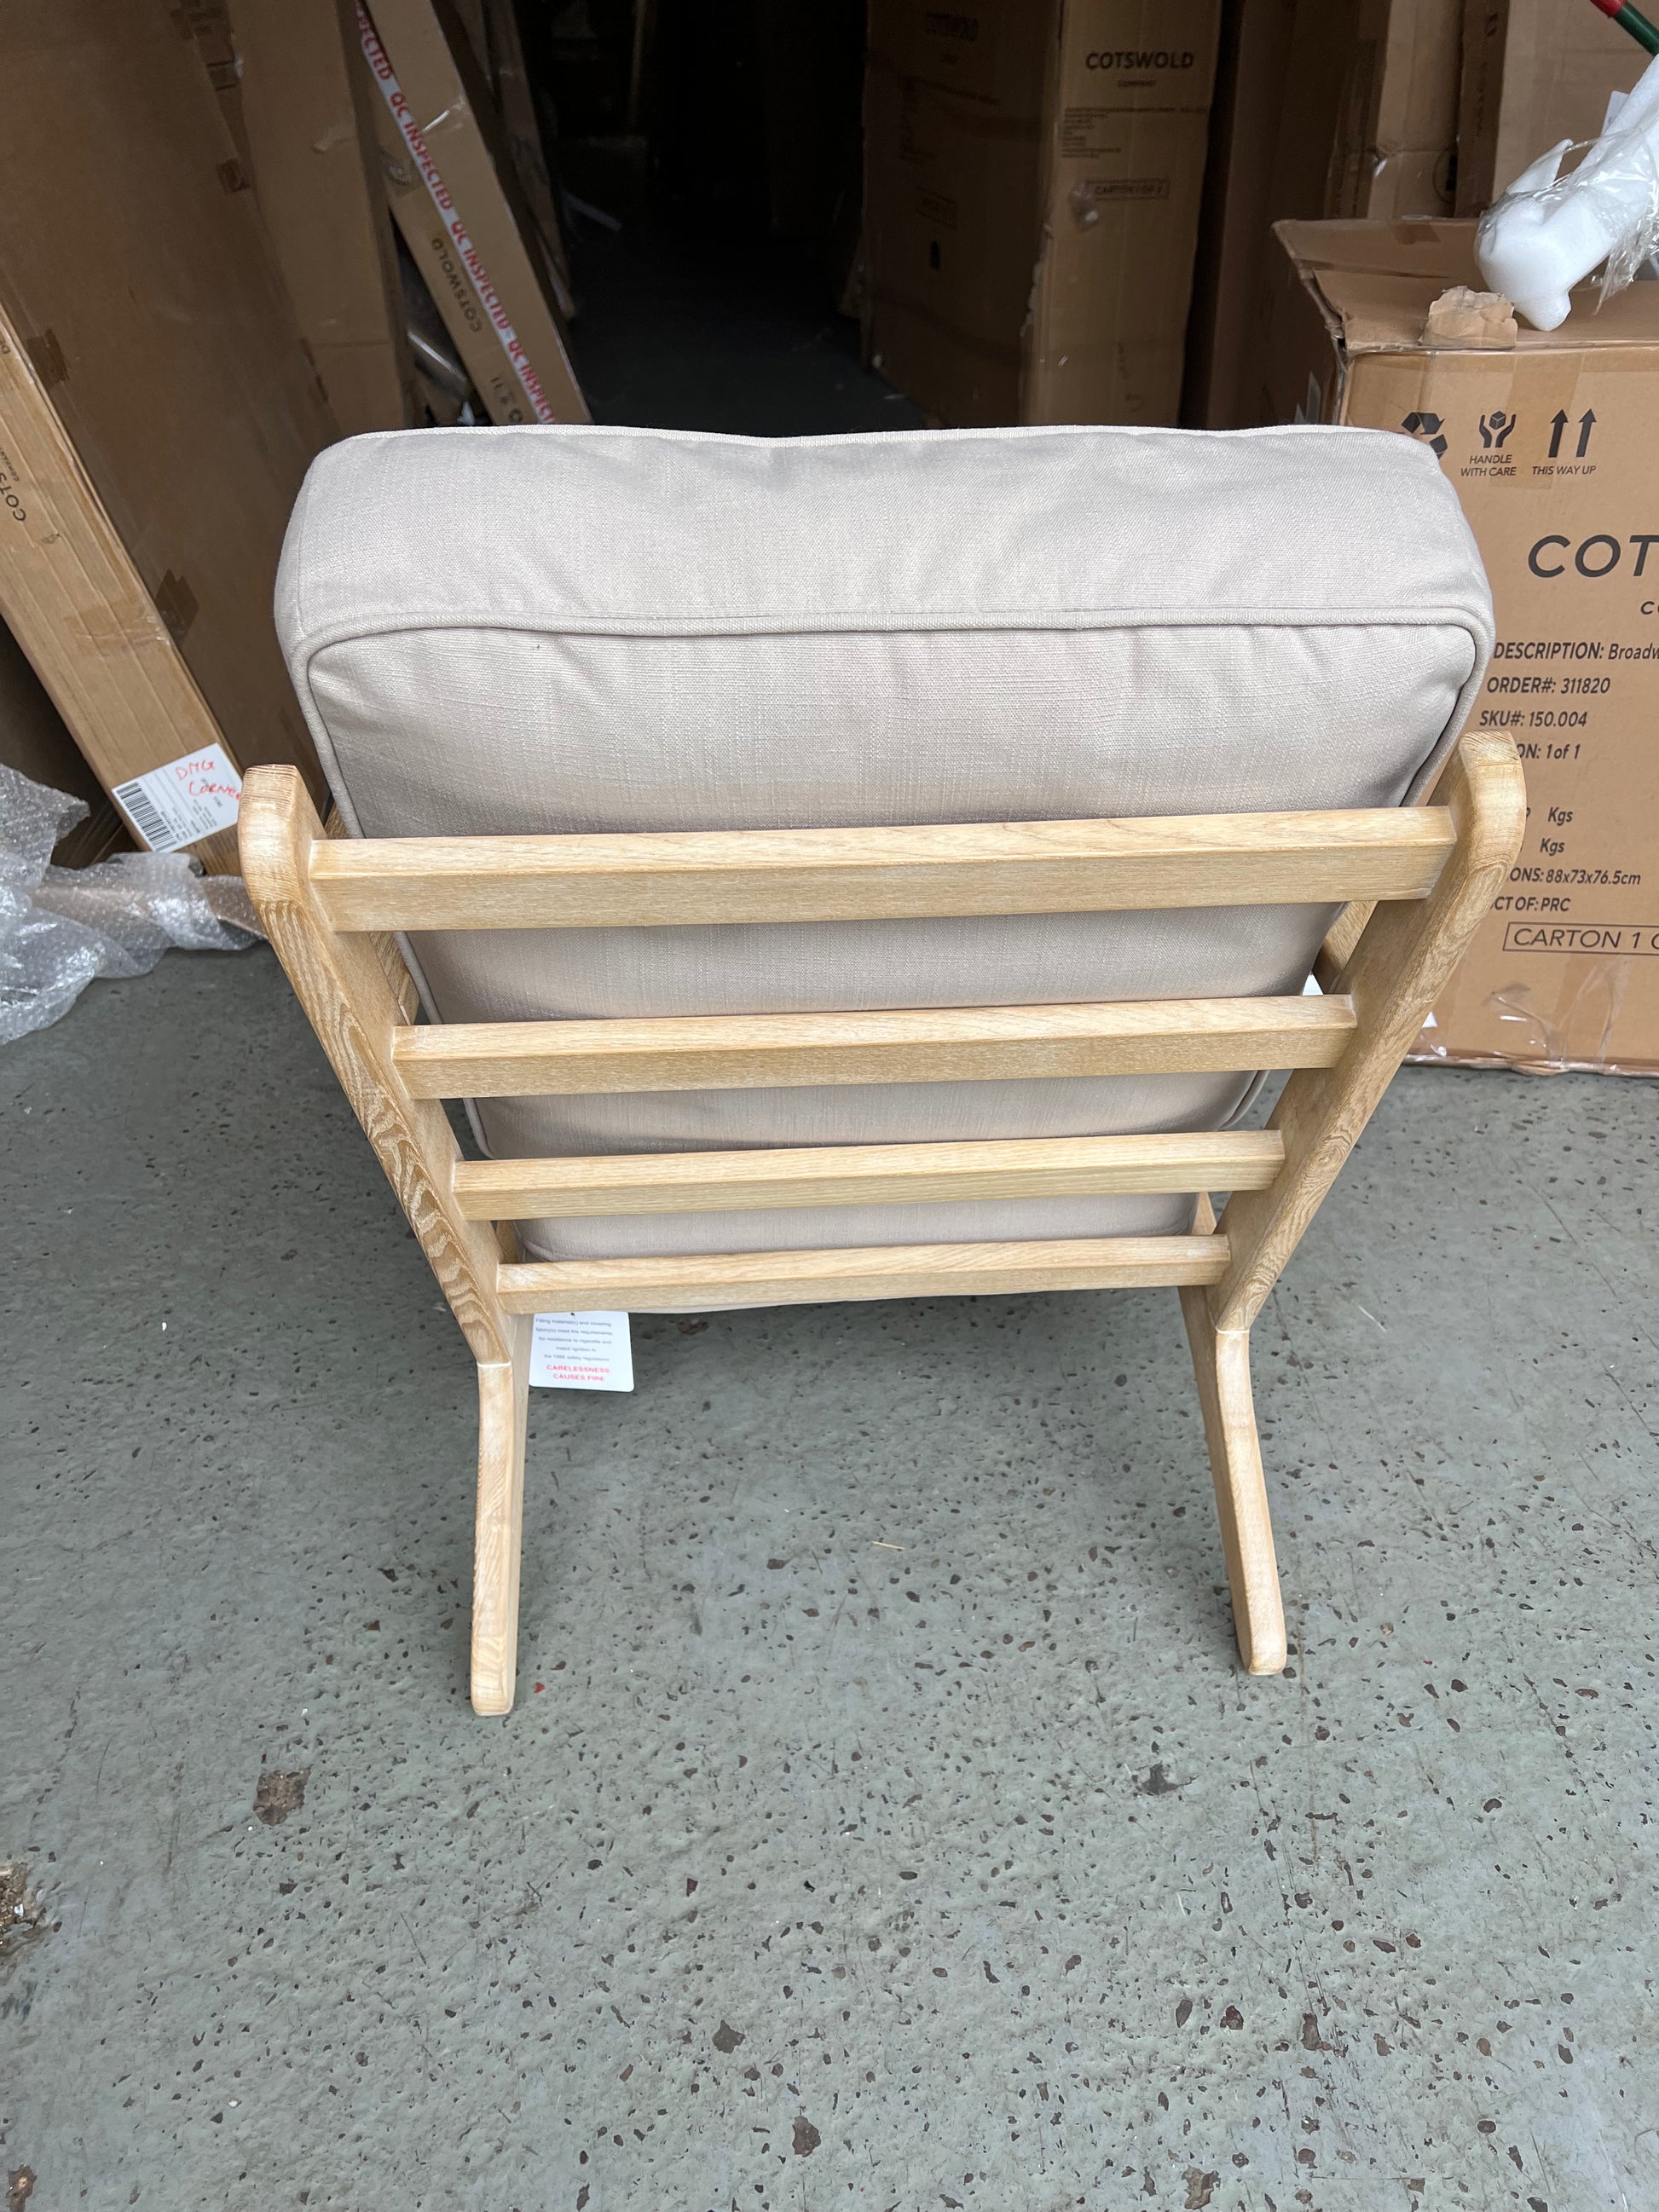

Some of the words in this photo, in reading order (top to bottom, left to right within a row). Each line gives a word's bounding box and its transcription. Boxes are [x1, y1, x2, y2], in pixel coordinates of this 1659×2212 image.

[1085, 51, 1194, 70] COTSWOLD
[390, 90, 409, 120] QC
[404, 121, 454, 211] INSPECTED
[431, 237, 483, 332] COTSWOLD
[451, 220, 469, 247] QC
[464, 248, 512, 331] INSPECTED
[507, 339, 529, 364] QC
[1469, 454, 1512, 465] HANDLE
[1460, 467, 1487, 477] WITH
[1488, 466, 1517, 476] CARE
[1532, 465, 1554, 476] THIS
[1556, 465, 1580, 475] WAY
[1581, 465, 1597, 475] UP
[1528, 534, 1659, 578] COT
[1494, 642, 1604, 660] DESCRIPTION:
[1487, 677, 1557, 693] ORDER#:
[1560, 677, 1611, 694] 311820
[1479, 710, 1525, 726] SKU#:
[1529, 711, 1588, 727] 150.004
[1575, 744, 1581, 759] 1
[1547, 806, 1574, 826] Kgs
[1540, 838, 1565, 856] Kgs
[1546, 869, 1641, 886] 88x73x76.5cm
[1514, 897, 1540, 911] OF:
[1540, 898, 1570, 912] PRC
[1514, 927, 1621, 949] CARTON
[1632, 931, 1641, 949] 1
[546, 1364, 610, 1373] CARELESSNESS
